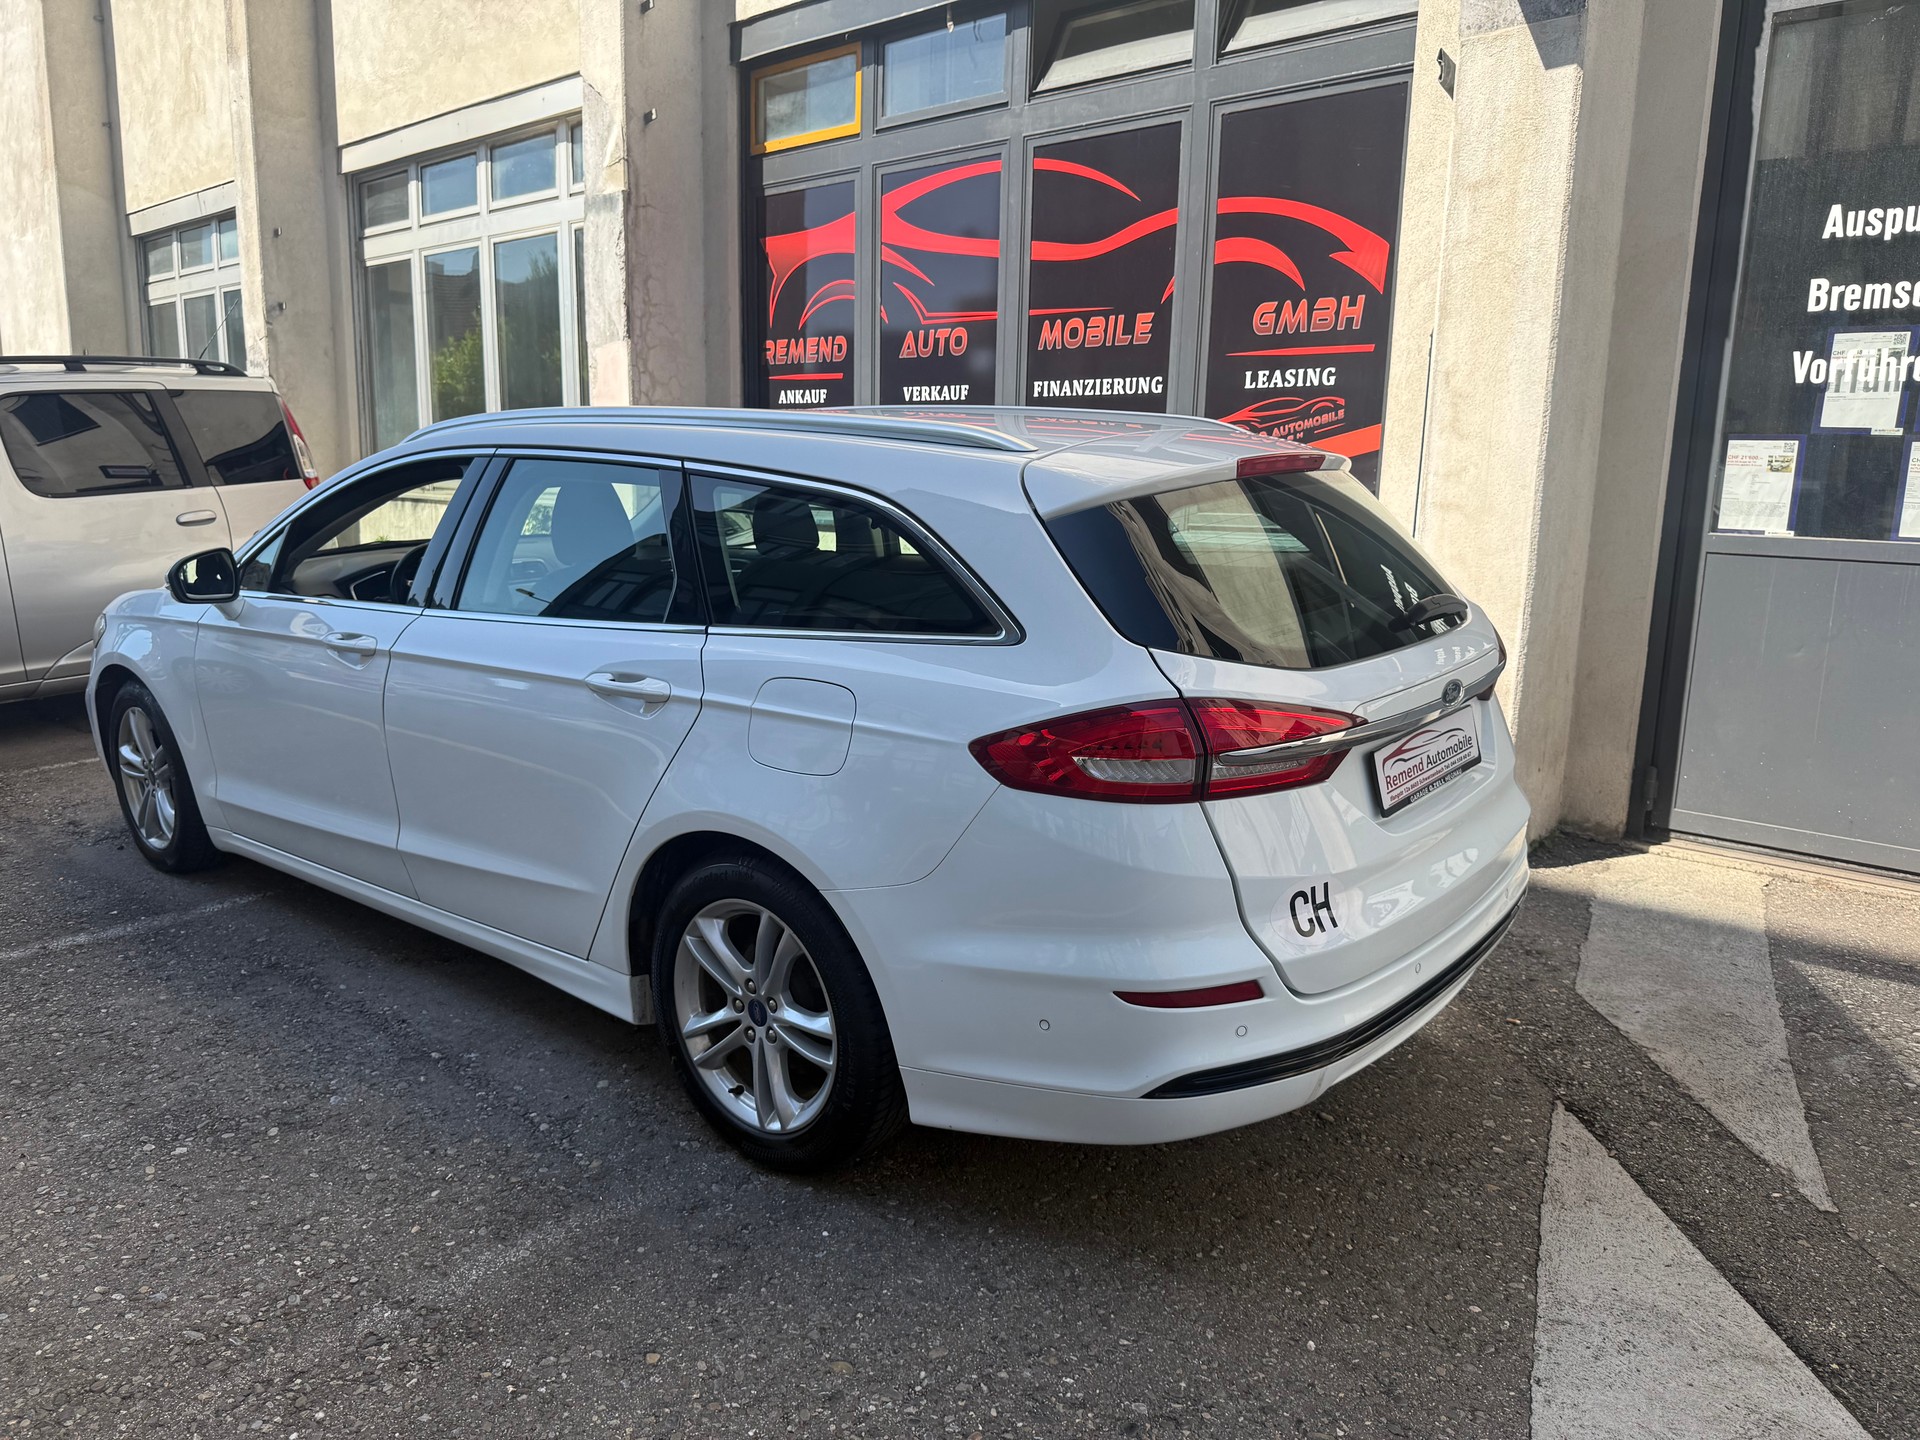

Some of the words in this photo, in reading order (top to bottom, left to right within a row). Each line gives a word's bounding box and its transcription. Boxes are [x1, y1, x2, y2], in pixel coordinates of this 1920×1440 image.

[1821, 203, 1920, 241] Auspu
[766, 335, 848, 365] REMEND
[899, 326, 968, 359] AUTO
[1037, 311, 1156, 351] MOBILE
[1251, 294, 1367, 336] GMBH
[1033, 375, 1164, 398] FINANZIERUNG
[1243, 366, 1338, 390] LEASING
[778, 388, 828, 404] ANKAUF
[902, 384, 970, 402] VERKAUF
[1272, 408, 1345, 437] AUTOMOBILE
[1385, 757, 1424, 791] Remend
[1426, 734, 1473, 769] Automobile
[1289, 881, 1338, 938] CH
